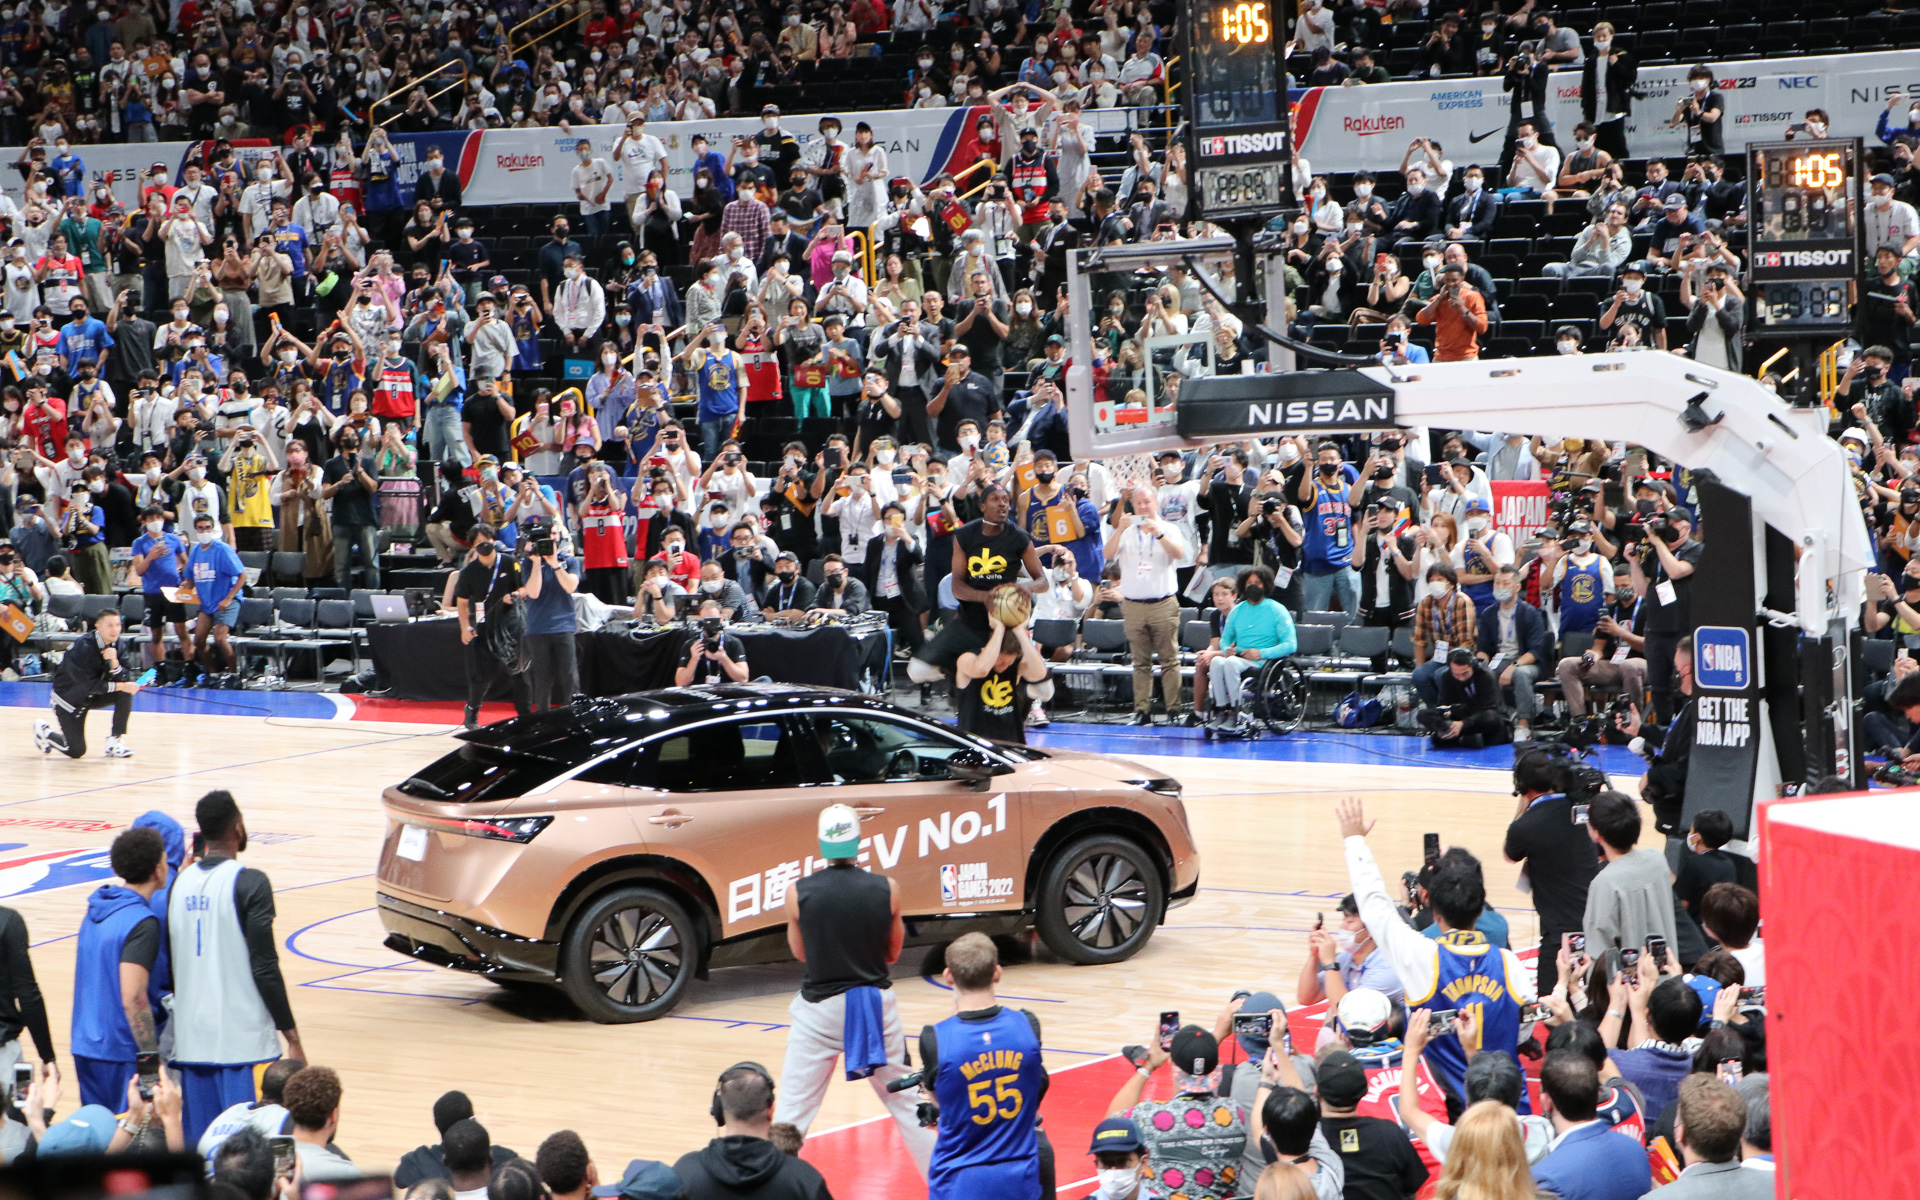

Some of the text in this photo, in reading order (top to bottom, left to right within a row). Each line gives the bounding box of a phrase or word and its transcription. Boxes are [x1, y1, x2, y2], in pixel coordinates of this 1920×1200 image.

[1222, 3, 1269, 43] 1:05
[1708, 77, 1757, 91] A2K23
[1778, 76, 1818, 89] NEC
[1430, 89, 1482, 101] AMERICAN
[1437, 99, 1484, 110] EXPRESS
[1643, 90, 1670, 99] ROUP
[1344, 114, 1405, 131] Rakuten
[1752, 112, 1794, 123] TISSOT
[1224, 132, 1286, 154] TISSOT
[497, 153, 544, 168] Rakuten
[1794, 153, 1843, 188] 1:05
[1781, 250, 1852, 266] TISSOT
[1248, 398, 1388, 426] NISSAN
[1497, 495, 1547, 526] JAPAN
[1056, 519, 1068, 535] 6
[1715, 645, 1743, 671] NBA
[1698, 696, 1749, 722] GET THE
[1697, 722, 1751, 747] NBA APP
[918, 792, 1006, 858] No.1
[957, 862, 988, 882] JAPAN
[958, 877, 1014, 899] GAMES 2022
[197, 918, 201, 957] 1
[1441, 974, 1504, 1002] THOMPSON
[967, 1073, 1024, 1125] 55
